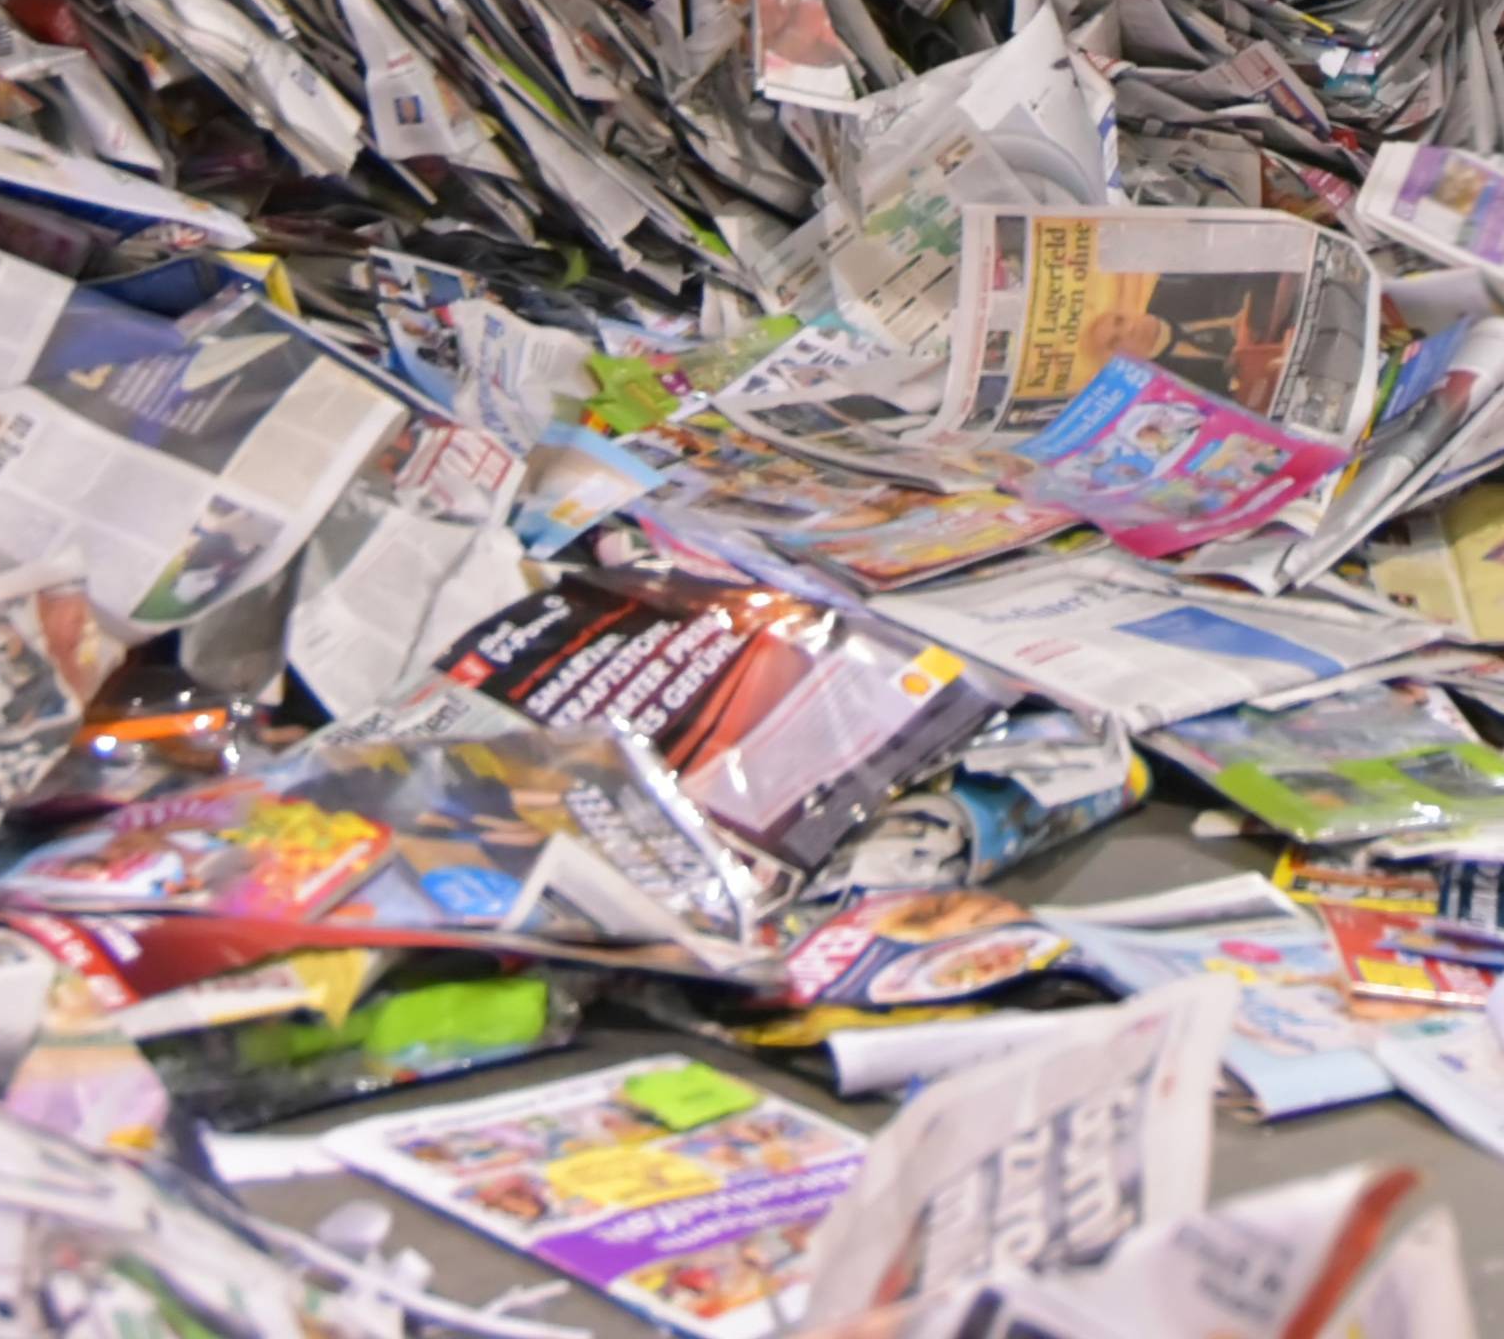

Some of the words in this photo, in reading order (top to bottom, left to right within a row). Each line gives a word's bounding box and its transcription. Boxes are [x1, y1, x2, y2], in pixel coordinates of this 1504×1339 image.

[1067, 220, 1091, 282] ohne
[1037, 227, 1067, 335] Lagerfeld
[1060, 288, 1086, 345] oben
[1027, 342, 1053, 388] Karl
[1052, 353, 1076, 393] mal
